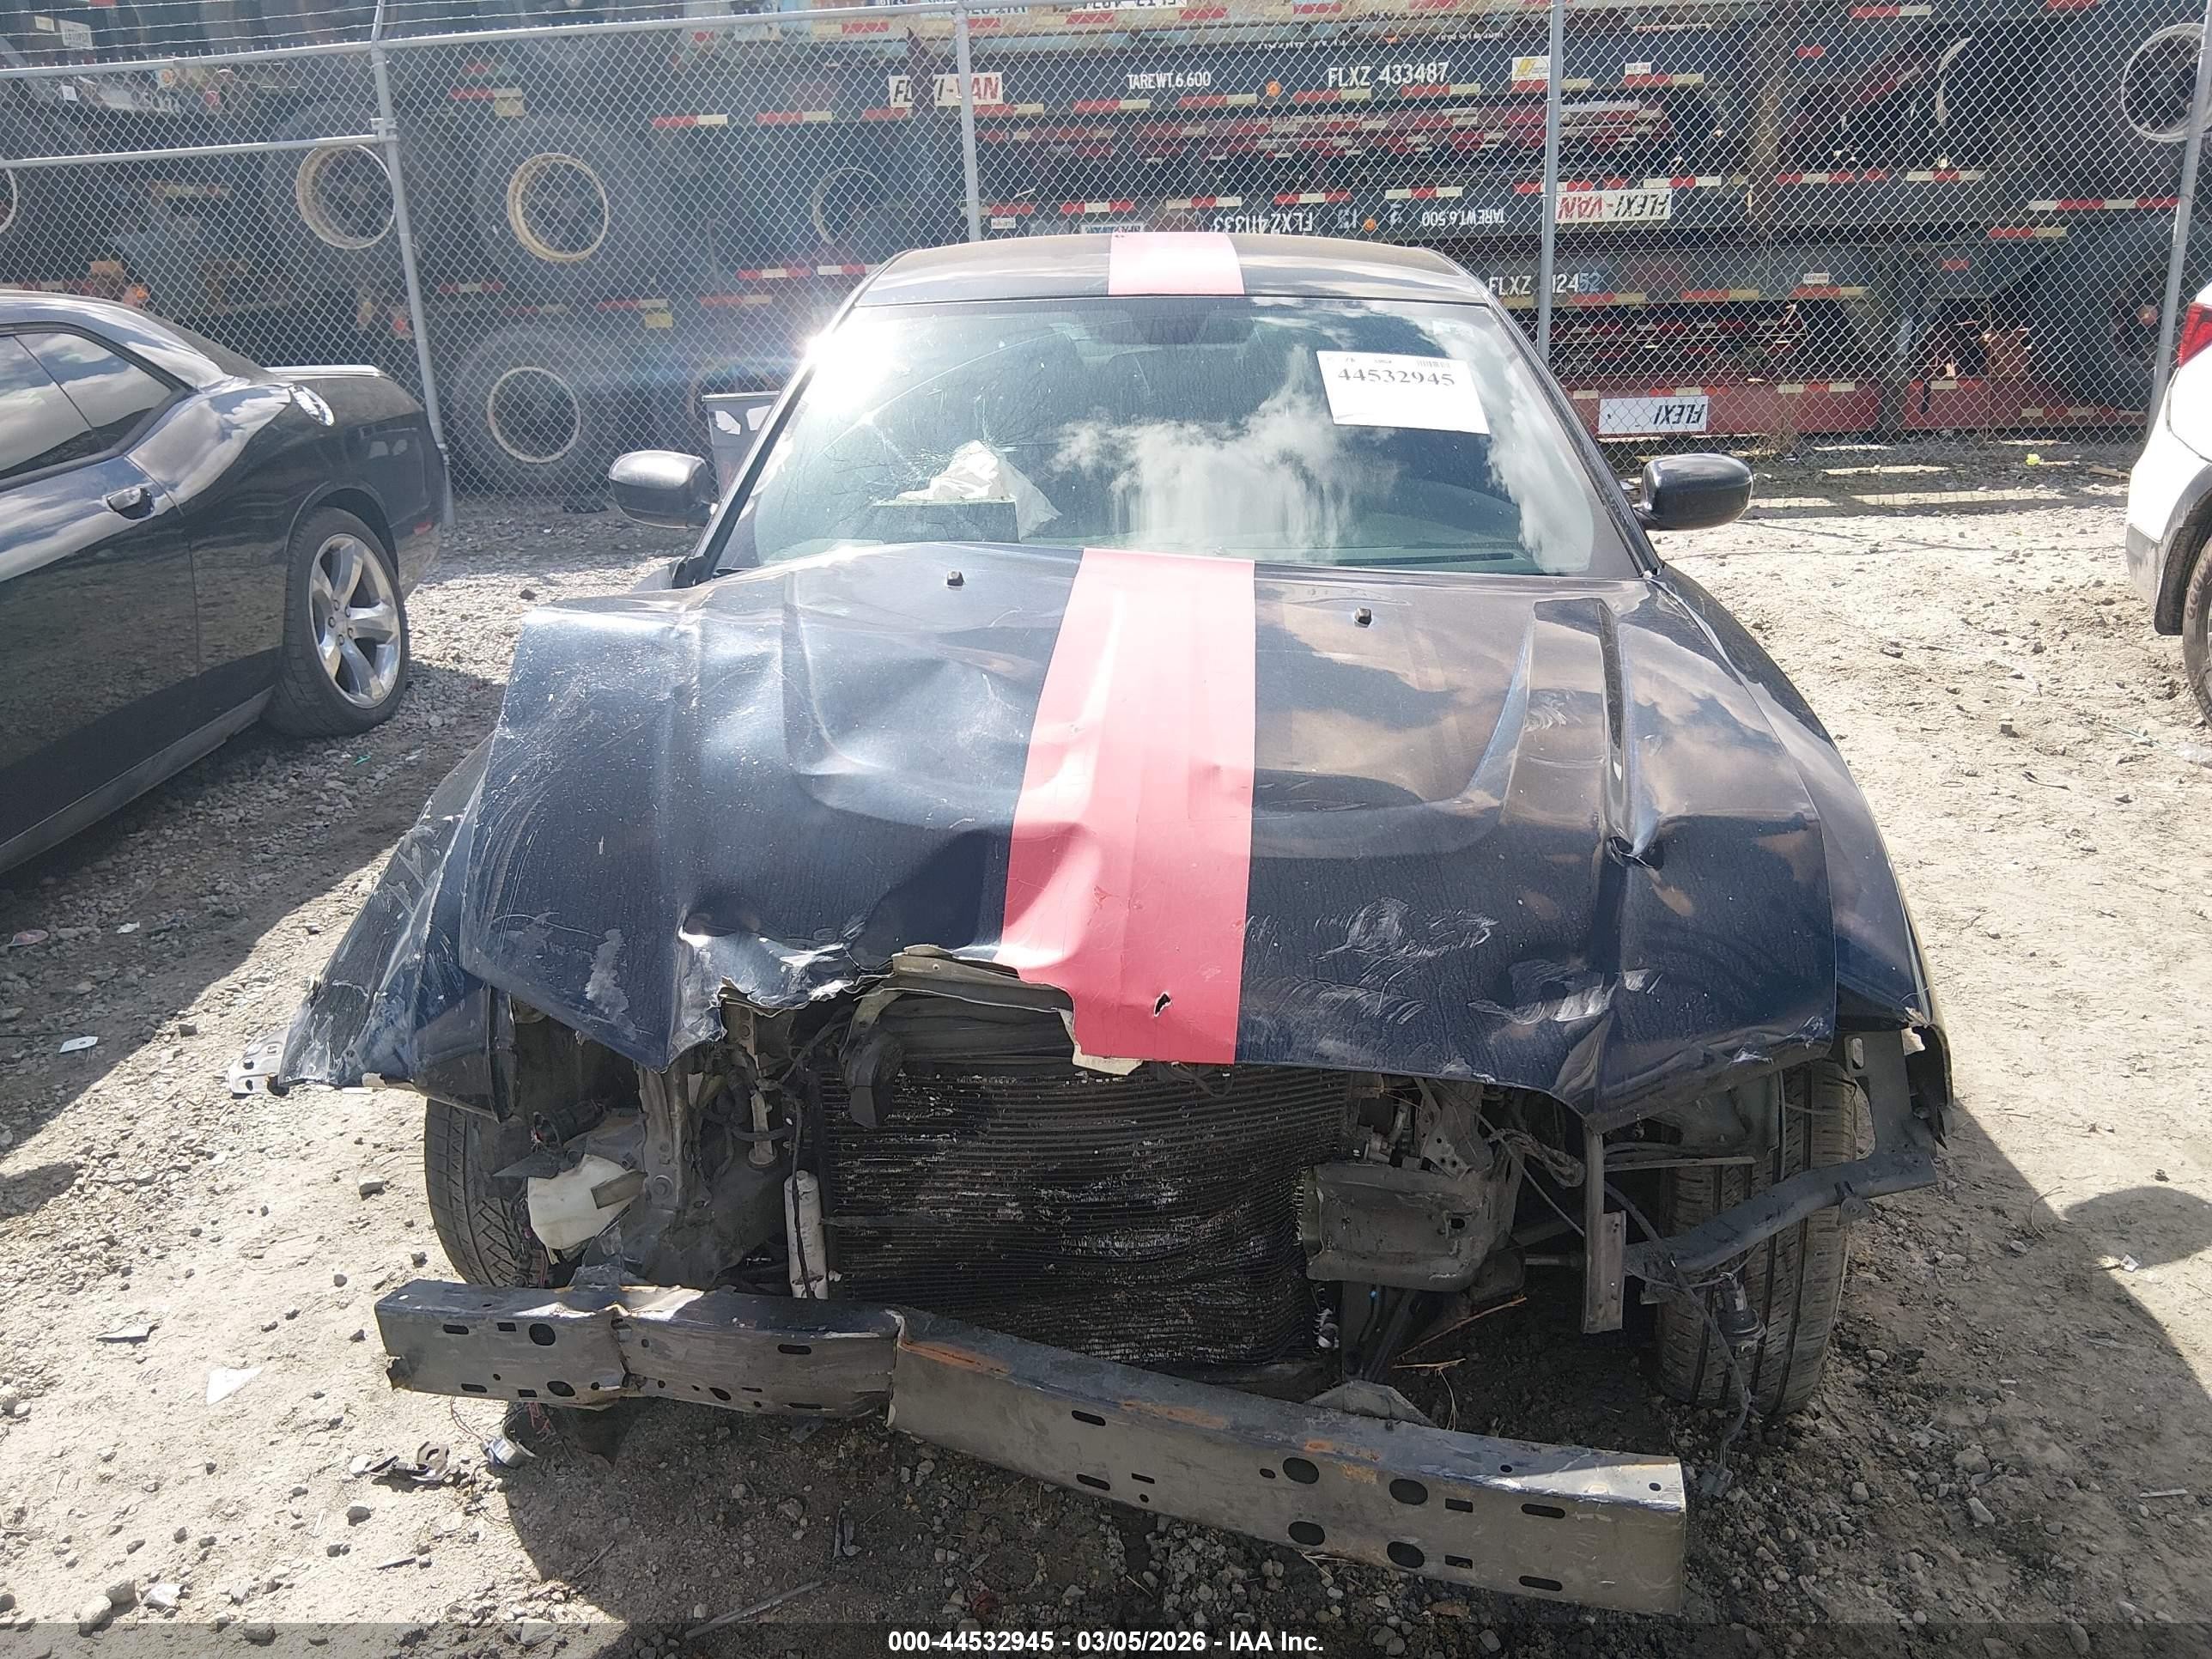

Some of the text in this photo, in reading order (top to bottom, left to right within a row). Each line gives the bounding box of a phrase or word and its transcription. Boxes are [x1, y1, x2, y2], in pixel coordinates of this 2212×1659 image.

[1328, 61, 1449, 88] FLXZ 433487
[1488, 271, 1602, 296] FLXZ 12452
[1338, 367, 1455, 386] 44532945
[1653, 404, 1706, 425] FLEXI
